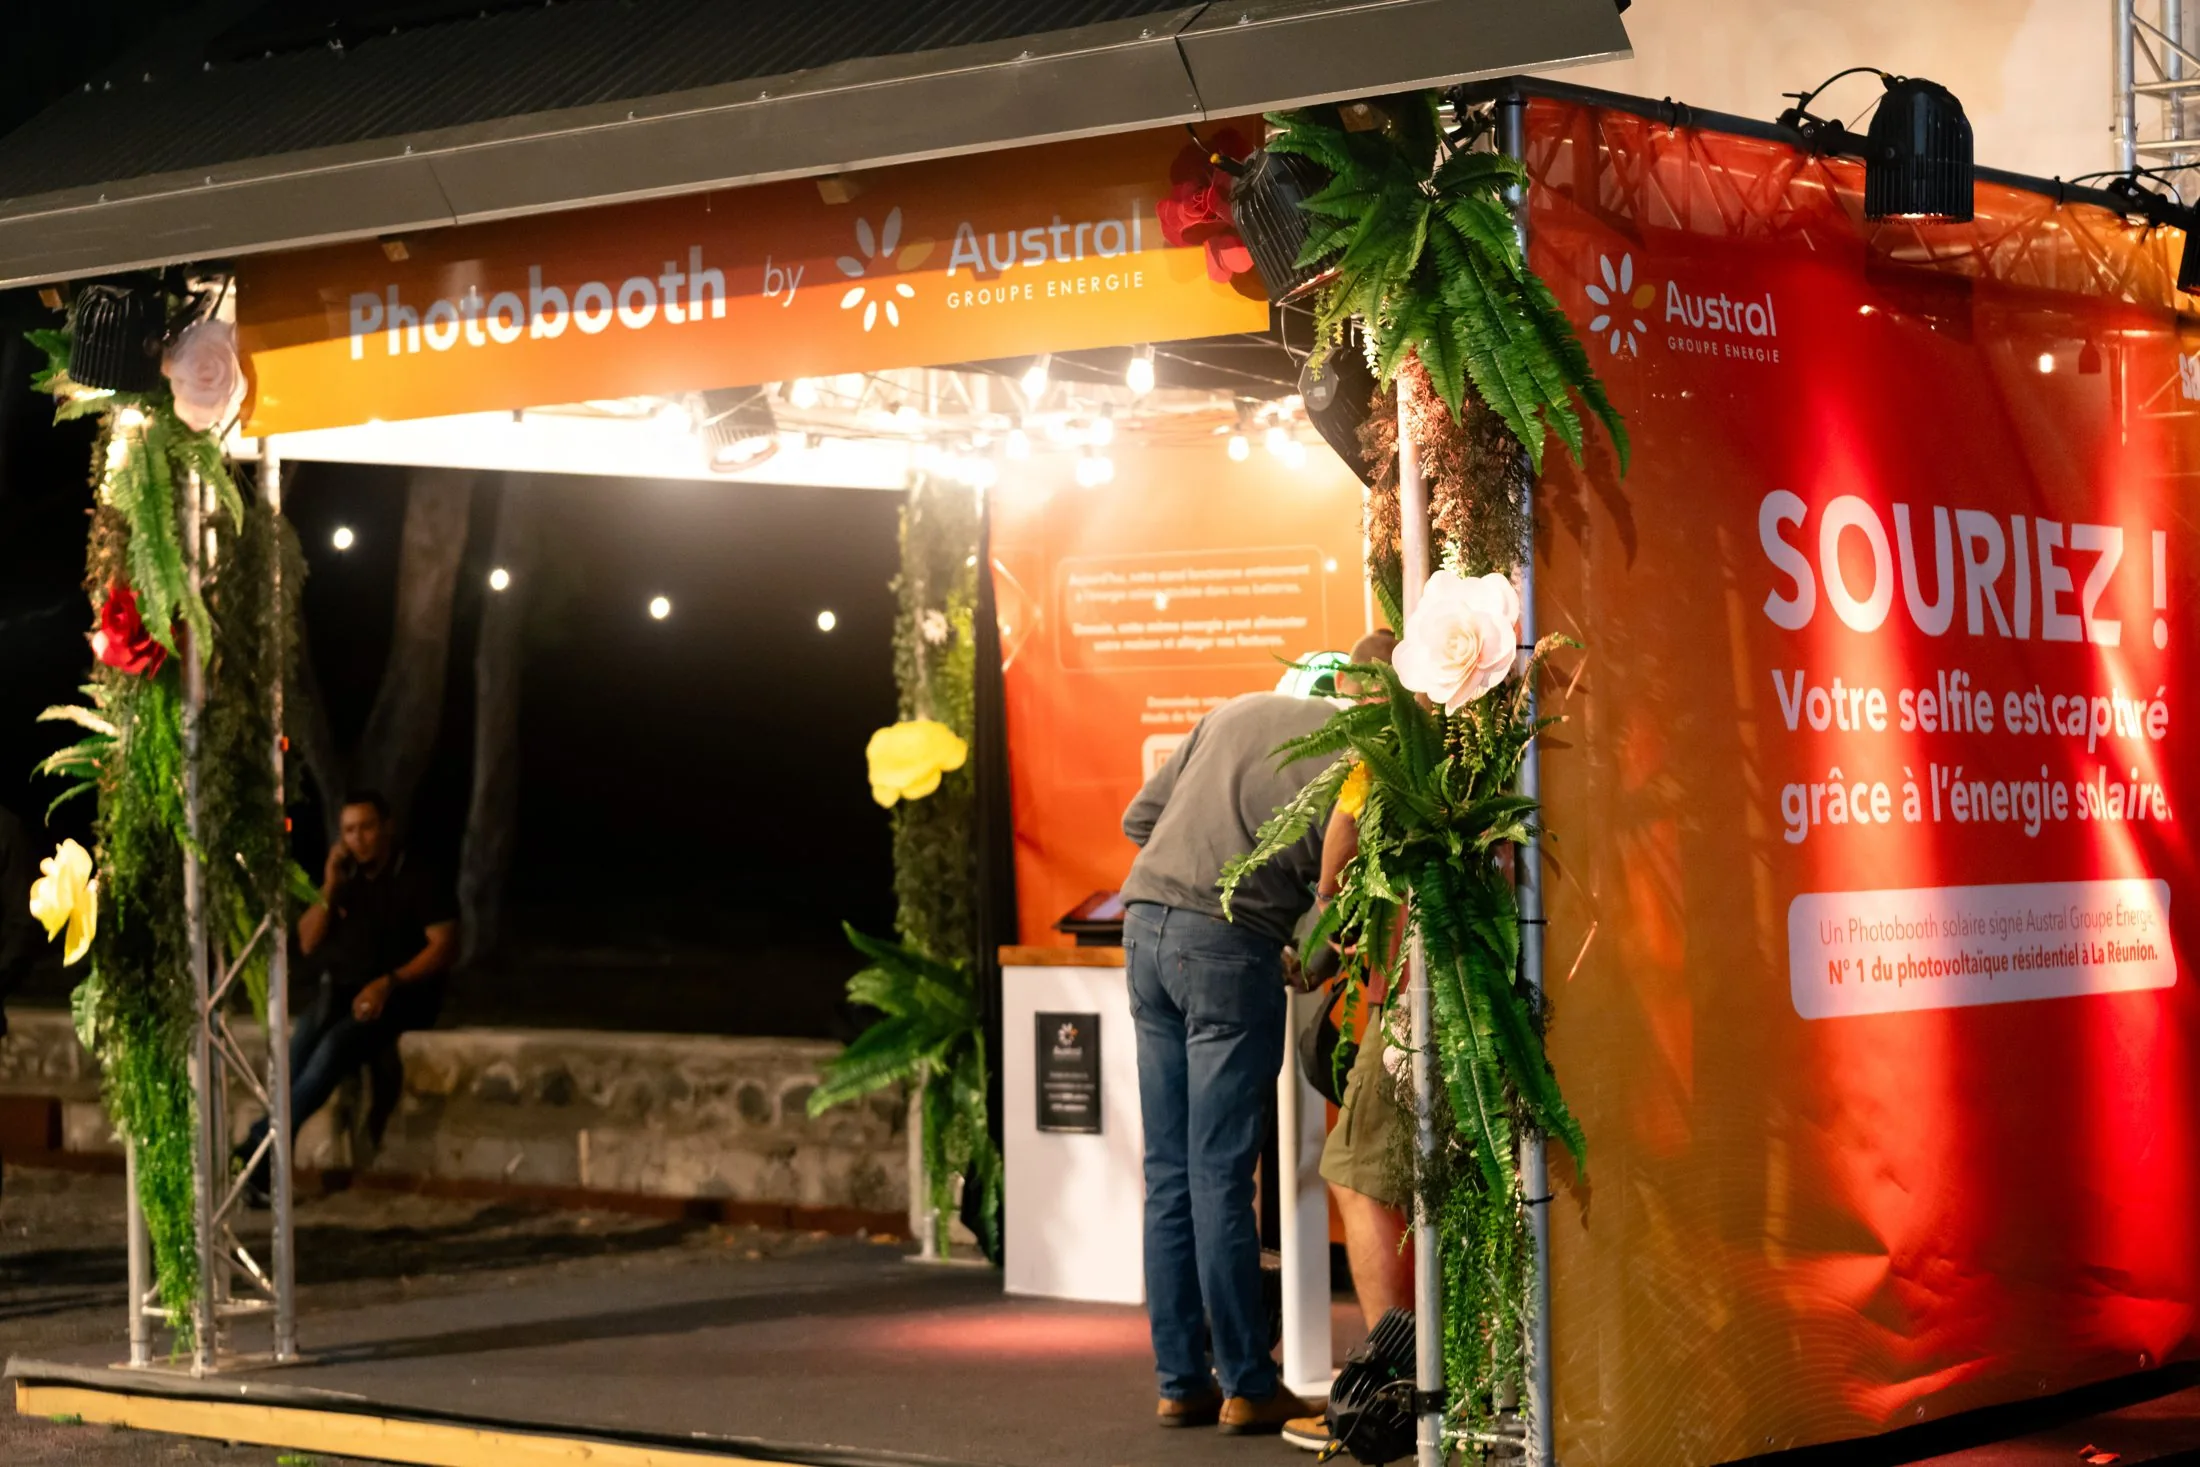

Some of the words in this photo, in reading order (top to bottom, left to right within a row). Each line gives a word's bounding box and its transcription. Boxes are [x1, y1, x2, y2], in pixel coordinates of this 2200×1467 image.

[947, 198, 1142, 277] Austral
[349, 245, 727, 360] Photobooth
[762, 255, 805, 307] by
[947, 284, 1033, 309] GROUPE
[1047, 272, 1144, 298] ENERGIE
[1665, 280, 1777, 337] Austral
[1668, 336, 1718, 356] GROUPE
[1725, 344, 1780, 364] ENERGIE
[1758, 489, 2124, 648] SOURIEZ
[2152, 530, 2169, 650] !
[1772, 669, 1888, 732] Votre
[1899, 669, 1994, 734] selfie
[2003, 685, 2051, 735] est
[2051, 685, 2169, 754] capturé
[1781, 767, 1892, 844] grâce
[1902, 767, 1922, 824] à
[1930, 763, 2068, 837] l'énergie
[2076, 765, 2173, 823] solaire.
[1820, 919, 1843, 946] Un
[1849, 912, 1938, 943] Photobooth
[1943, 911, 1986, 938] solaire
[1989, 910, 2023, 942] signé
[2026, 907, 2067, 933] Austral
[2070, 905, 2113, 934] Groupe
[1856, 958, 1865, 982] 1
[1871, 955, 1893, 982] du
[1897, 949, 2009, 988] photovoltaïque
[2012, 942, 2079, 971] résidentiel
[2082, 943, 2089, 965] à
[2091, 942, 2105, 964] La
[2107, 938, 2158, 963] Réunion.
